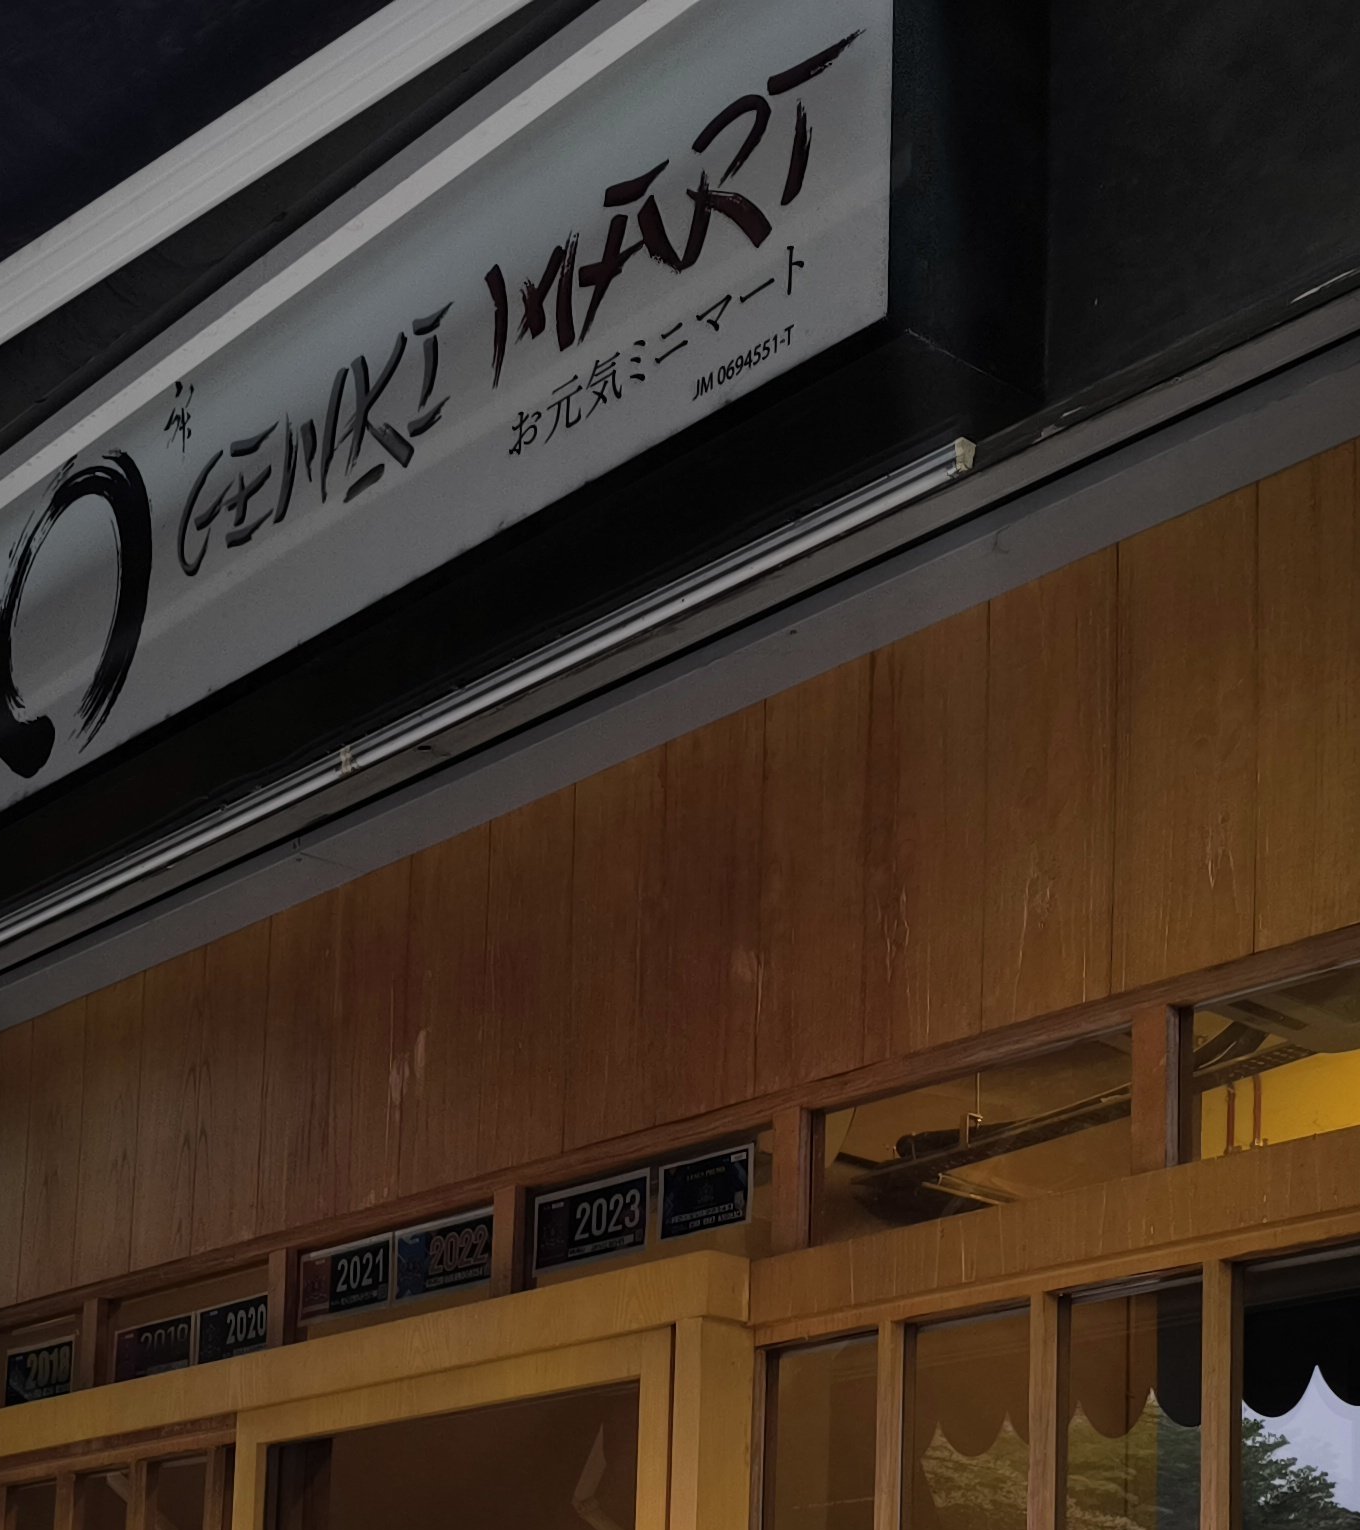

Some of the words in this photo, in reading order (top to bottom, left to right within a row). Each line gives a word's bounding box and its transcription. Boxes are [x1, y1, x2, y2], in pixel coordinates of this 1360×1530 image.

[177, 301, 455, 577] GENKI
[484, 28, 867, 389] MART
[508, 245, 805, 455] お元気ミニマート
[692, 372, 714, 401] JM
[717, 324, 795, 386] 0694551-T
[574, 1188, 641, 1241] 2023
[335, 1248, 384, 1293] 2021
[427, 1224, 489, 1276] 2022
[226, 1303, 267, 1345] 2020
[24, 1344, 70, 1390] 2018
